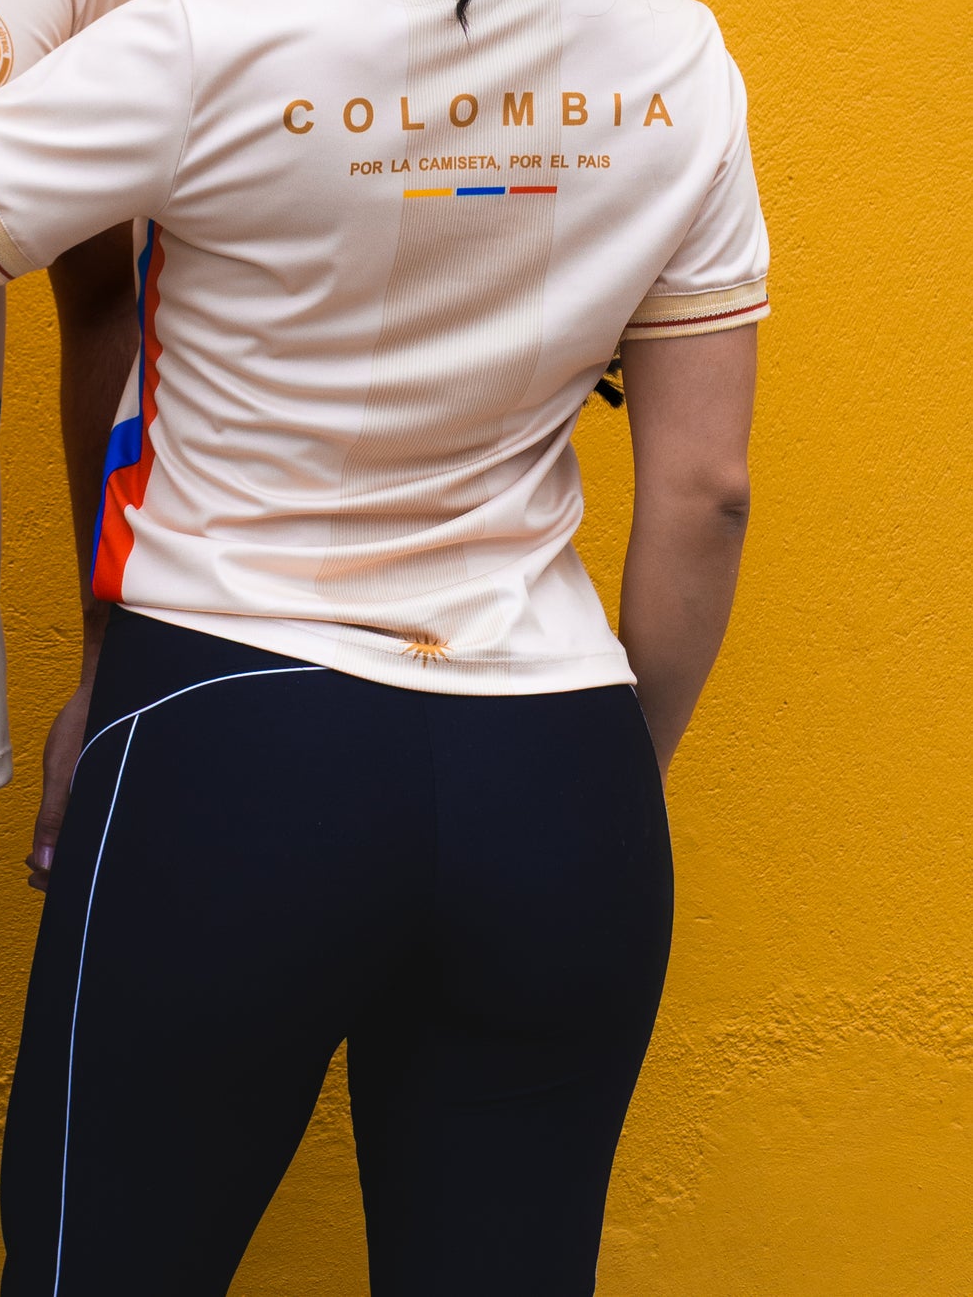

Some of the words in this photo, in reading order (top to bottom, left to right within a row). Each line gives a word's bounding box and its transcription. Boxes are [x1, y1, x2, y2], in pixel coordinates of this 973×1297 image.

[282, 91, 674, 135] COLOMBIA
[350, 160, 383, 176] POR
[391, 158, 411, 173] LA
[418, 155, 501, 172] CAMISETA,
[509, 154, 542, 169] POR
[550, 154, 569, 169] EL
[577, 154, 611, 169] PAIS
